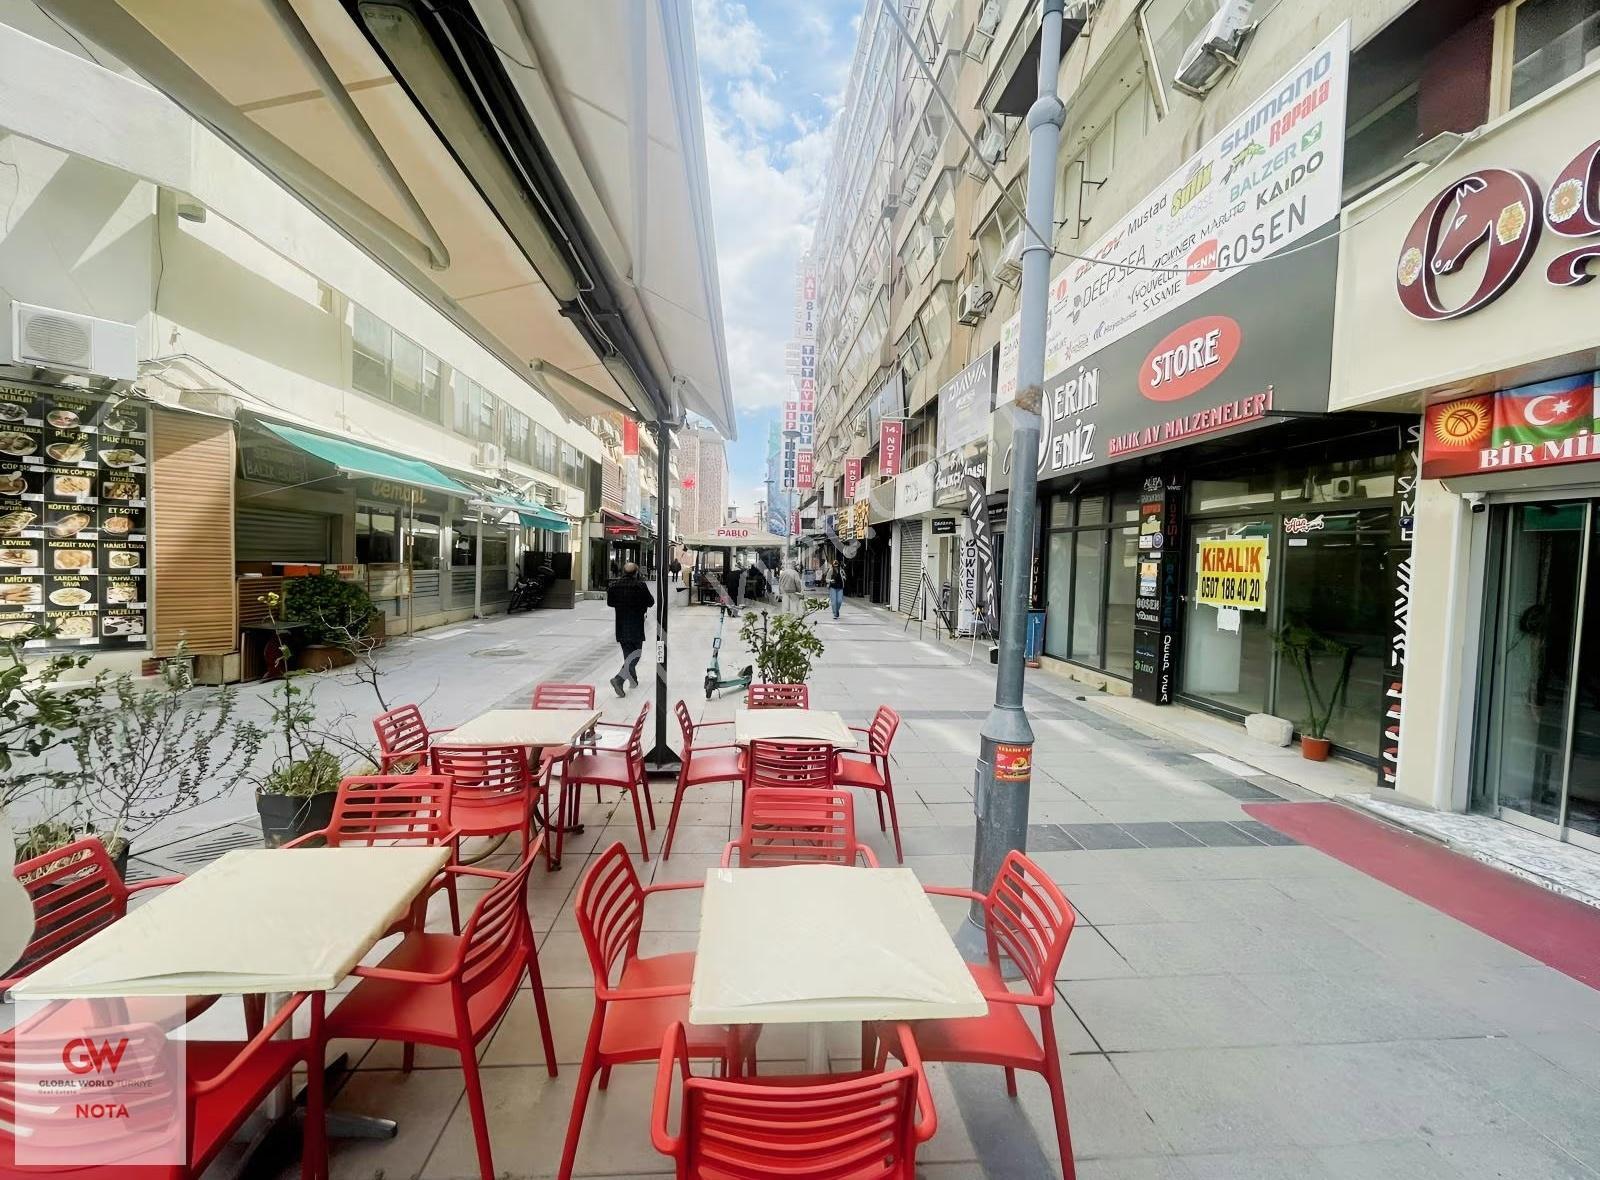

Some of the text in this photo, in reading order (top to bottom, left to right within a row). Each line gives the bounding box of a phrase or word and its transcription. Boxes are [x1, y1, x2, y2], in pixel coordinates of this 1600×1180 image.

[1220, 51, 1332, 159] SHIMANO
[1230, 141, 1297, 202] BALZER
[1127, 193, 1168, 237] Mustad
[1217, 194, 1307, 273] GOSEN
[1082, 266, 1117, 308] DEEP
[1150, 327, 1222, 388] STORE
[886, 436, 896, 475] NOTER
[1109, 430, 1141, 456] BALIK
[1144, 426, 1161, 446] AV
[1479, 440, 1535, 469] BİR
[717, 529, 749, 538] PABLO
[964, 546, 976, 600] OWNER
[1201, 578, 1260, 602] 0507 188 40 20
[1160, 635, 1172, 703] DEEP SEA
